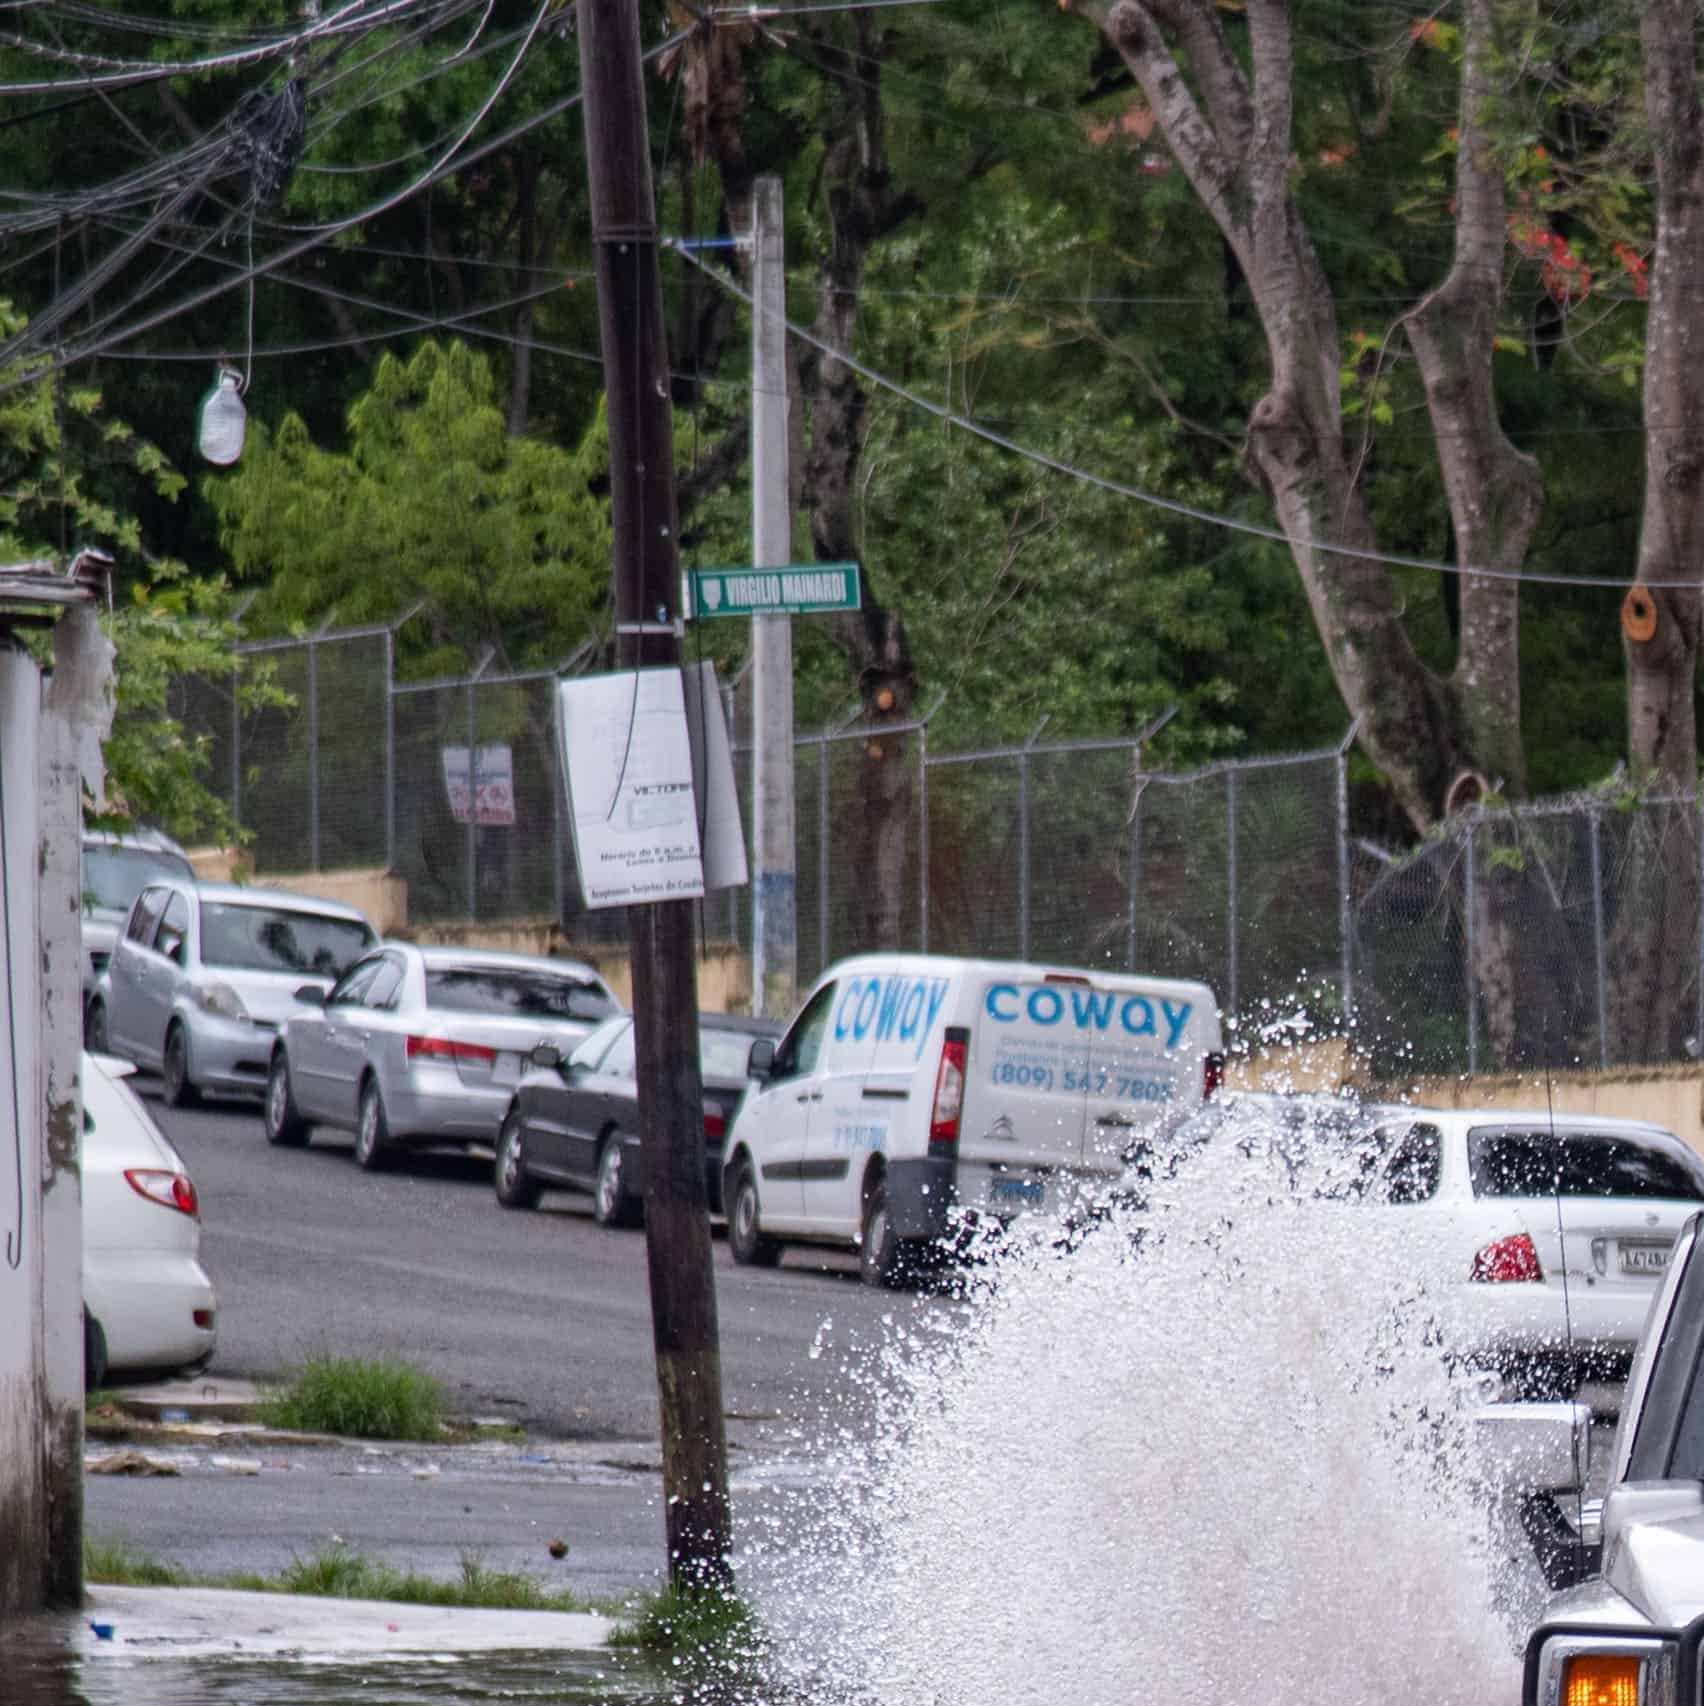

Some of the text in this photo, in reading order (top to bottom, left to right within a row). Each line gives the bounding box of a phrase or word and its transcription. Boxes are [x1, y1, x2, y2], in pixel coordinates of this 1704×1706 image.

[726, 576, 780, 608] VIRGILIO
[834, 976, 951, 1061] coway
[985, 984, 1193, 1050] coway
[992, 1063, 1054, 1093] (809)
